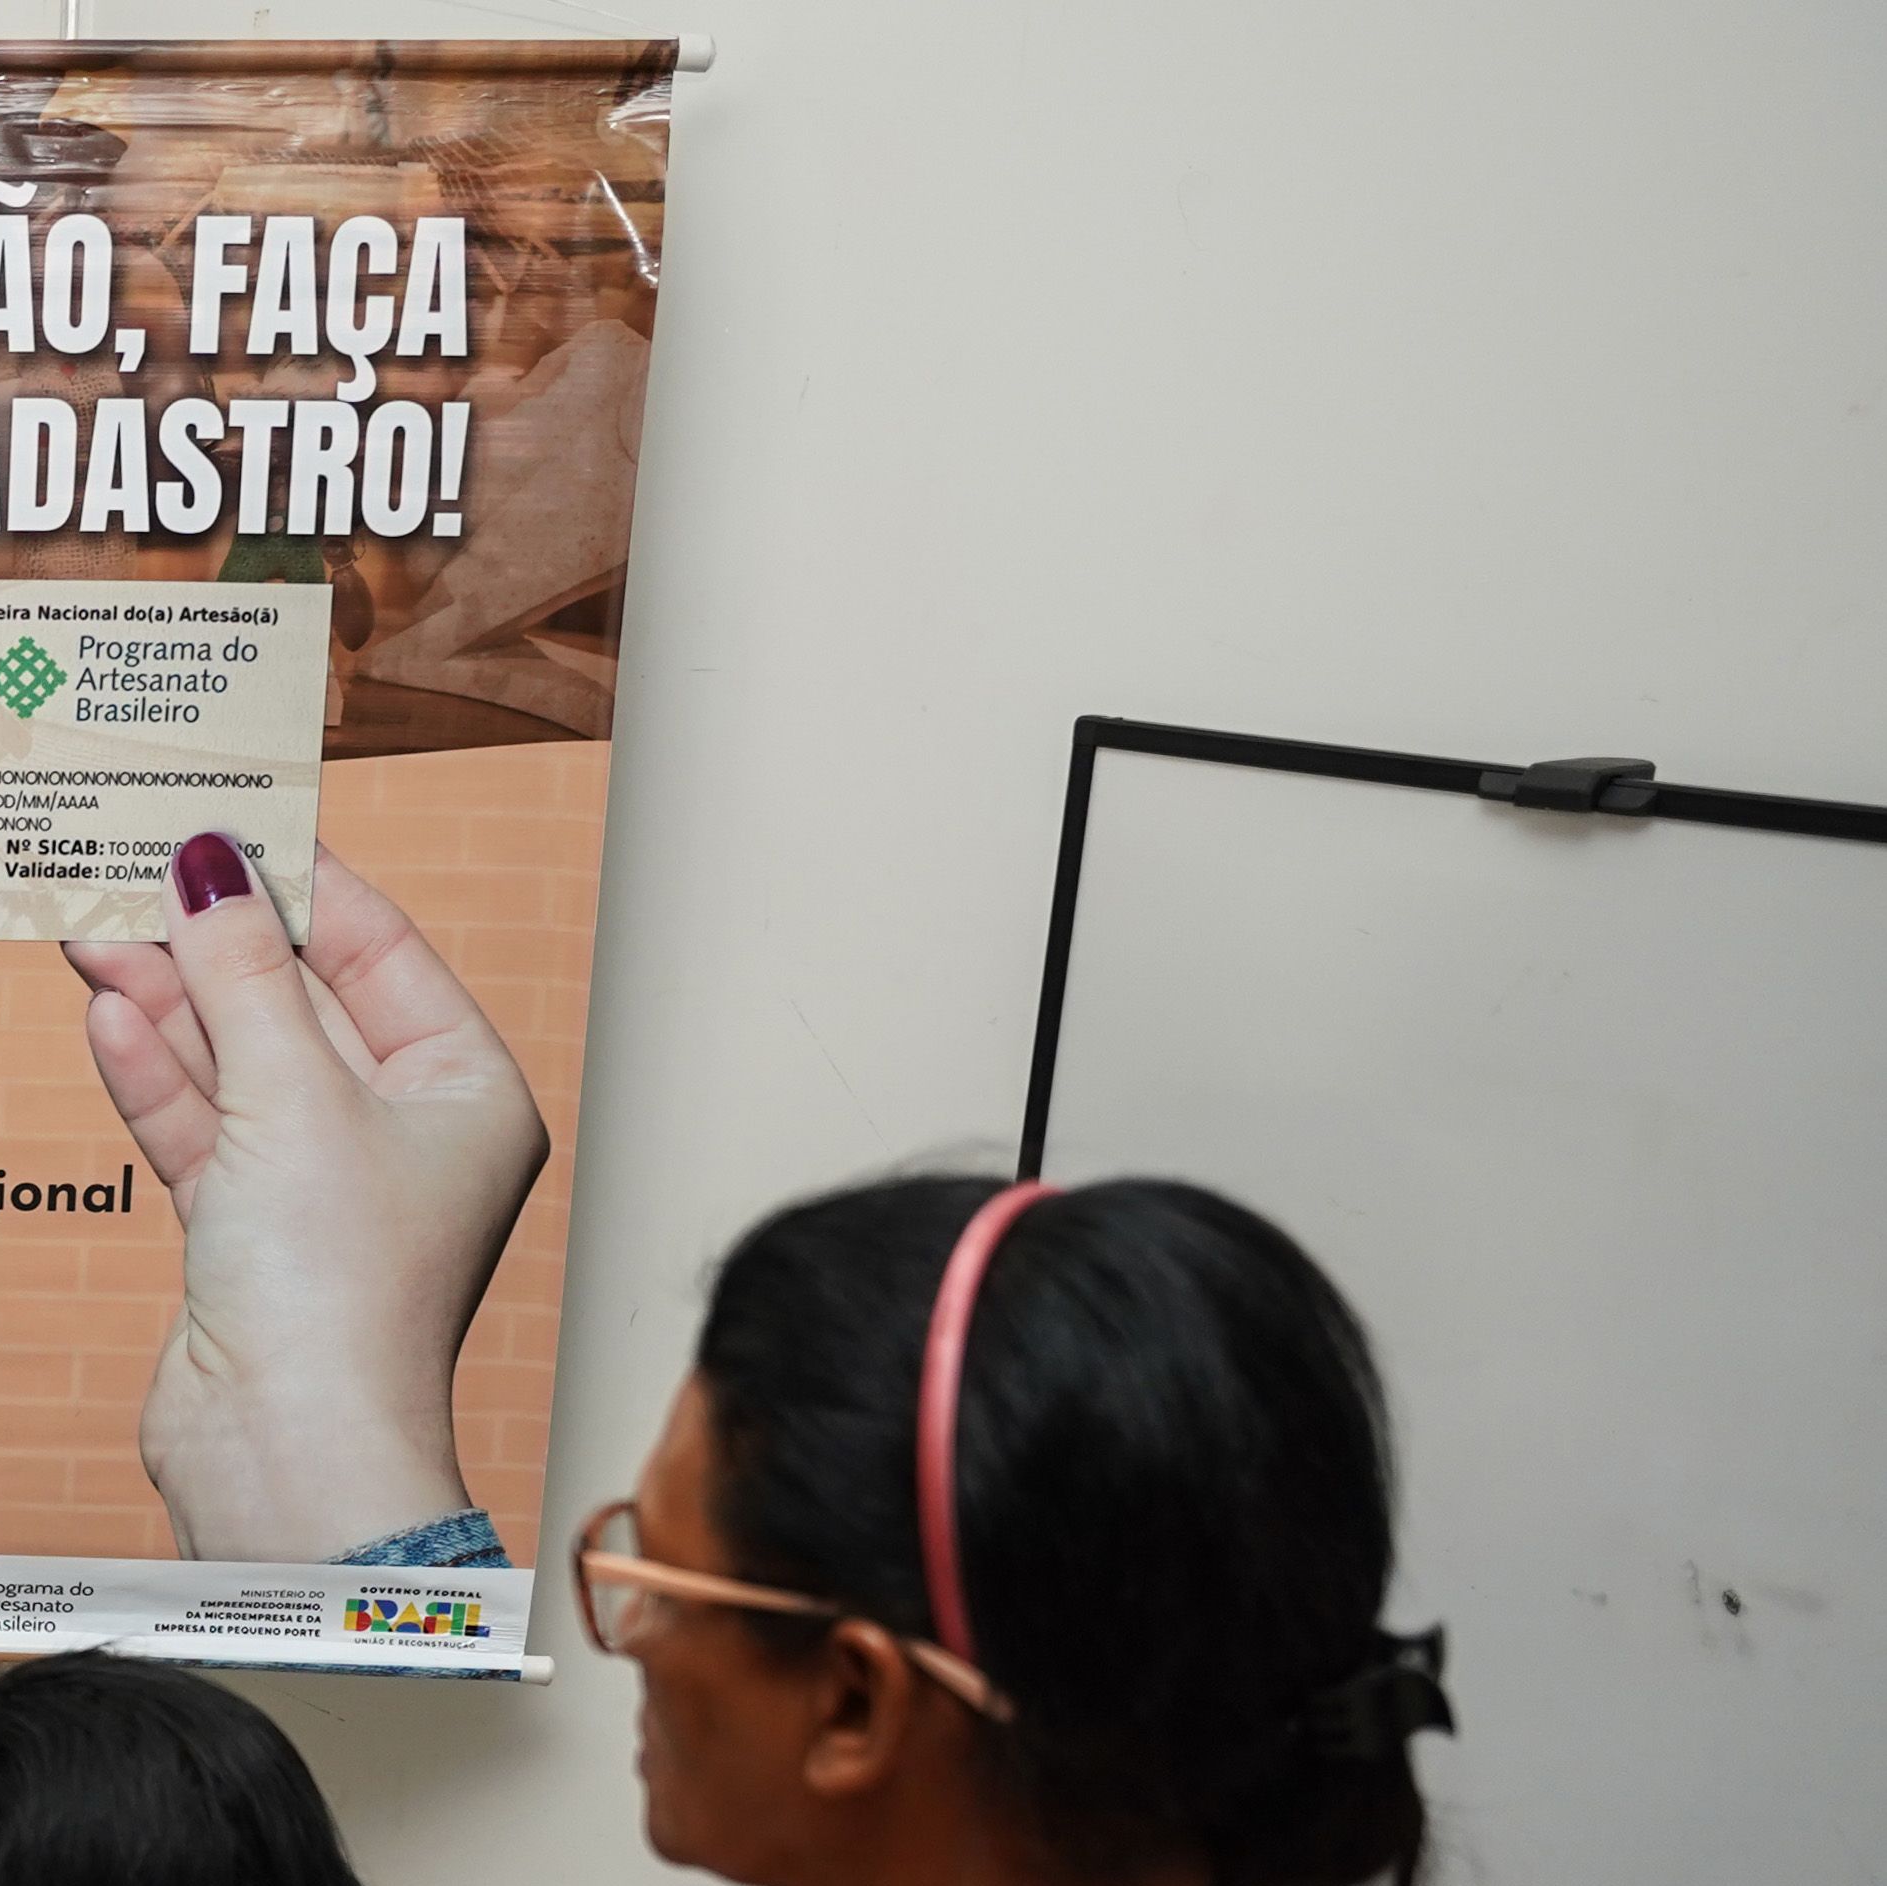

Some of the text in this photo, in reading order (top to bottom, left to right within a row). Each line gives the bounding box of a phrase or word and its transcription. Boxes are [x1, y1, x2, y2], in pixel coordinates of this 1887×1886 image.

[188, 215, 470, 403] FAÇA
[38, 605, 118, 621] Nacional
[123, 605, 173, 624] do(a)
[179, 606, 279, 625] Artesão(ã)
[79, 635, 258, 667] Programa do
[76, 667, 228, 694] Artesanato
[76, 697, 200, 723] Brasileiro
[38, 839, 104, 856] SICAB:
[108, 841, 130, 856] TO
[5, 862, 99, 879] Validade:
[106, 862, 170, 883] DD/MM/
[70, 1581, 94, 1597] do
[240, 1588, 325, 1599] MINISTÉRIO DO
[360, 1586, 482, 1599] GOVERNO FEDERAL
[200, 1600, 323, 1611] EMPREENDEDORISMO,
[186, 1611, 322, 1623] DA MICROEMPRESA E DA
[344, 1598, 491, 1637] BRASIL
[154, 1623, 321, 1637] EMPRESA DE PEQUENO PORTE
[355, 1636, 385, 1645] UNIÃO
